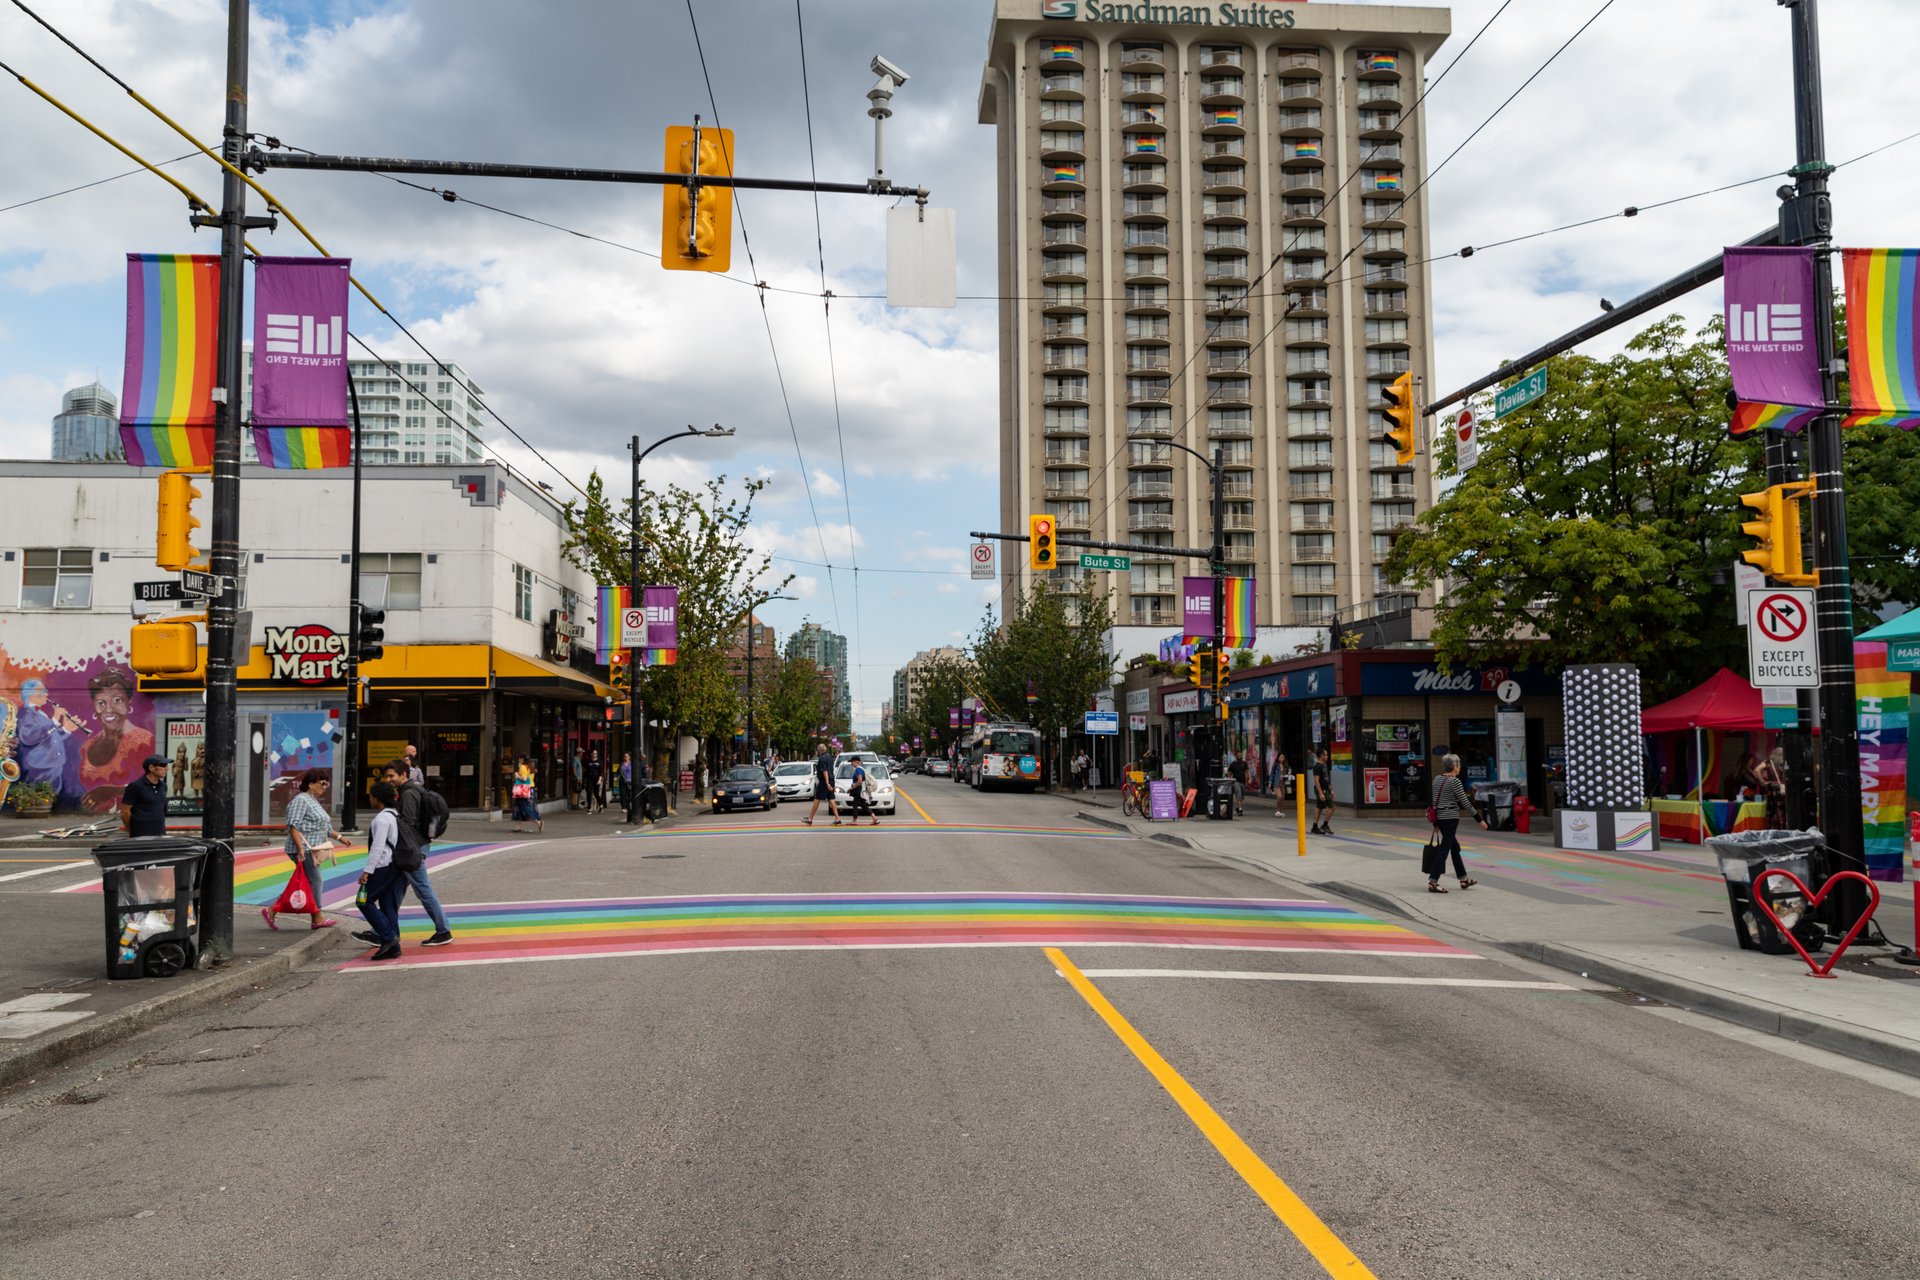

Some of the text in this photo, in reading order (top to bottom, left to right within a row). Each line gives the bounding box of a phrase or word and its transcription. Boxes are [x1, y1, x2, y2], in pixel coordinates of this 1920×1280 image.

[1085, 0, 1296, 28] Sandman Suites
[1731, 343, 1804, 352] THE WEST END
[1499, 375, 1541, 413] Davie St
[1084, 557, 1125, 569] Bute St
[186, 573, 204, 590] DAVIE
[142, 584, 171, 599] BUTE
[265, 628, 350, 661] Money
[1762, 650, 1805, 662] EXCEPT
[272, 654, 343, 679] Mart
[1758, 665, 1812, 677] BICYCLES
[1411, 668, 1475, 692] Mac's
[170, 723, 202, 736] HAIDA
[441, 743, 468, 751] OPEN
[1859, 696, 1882, 827] HEY MARY
